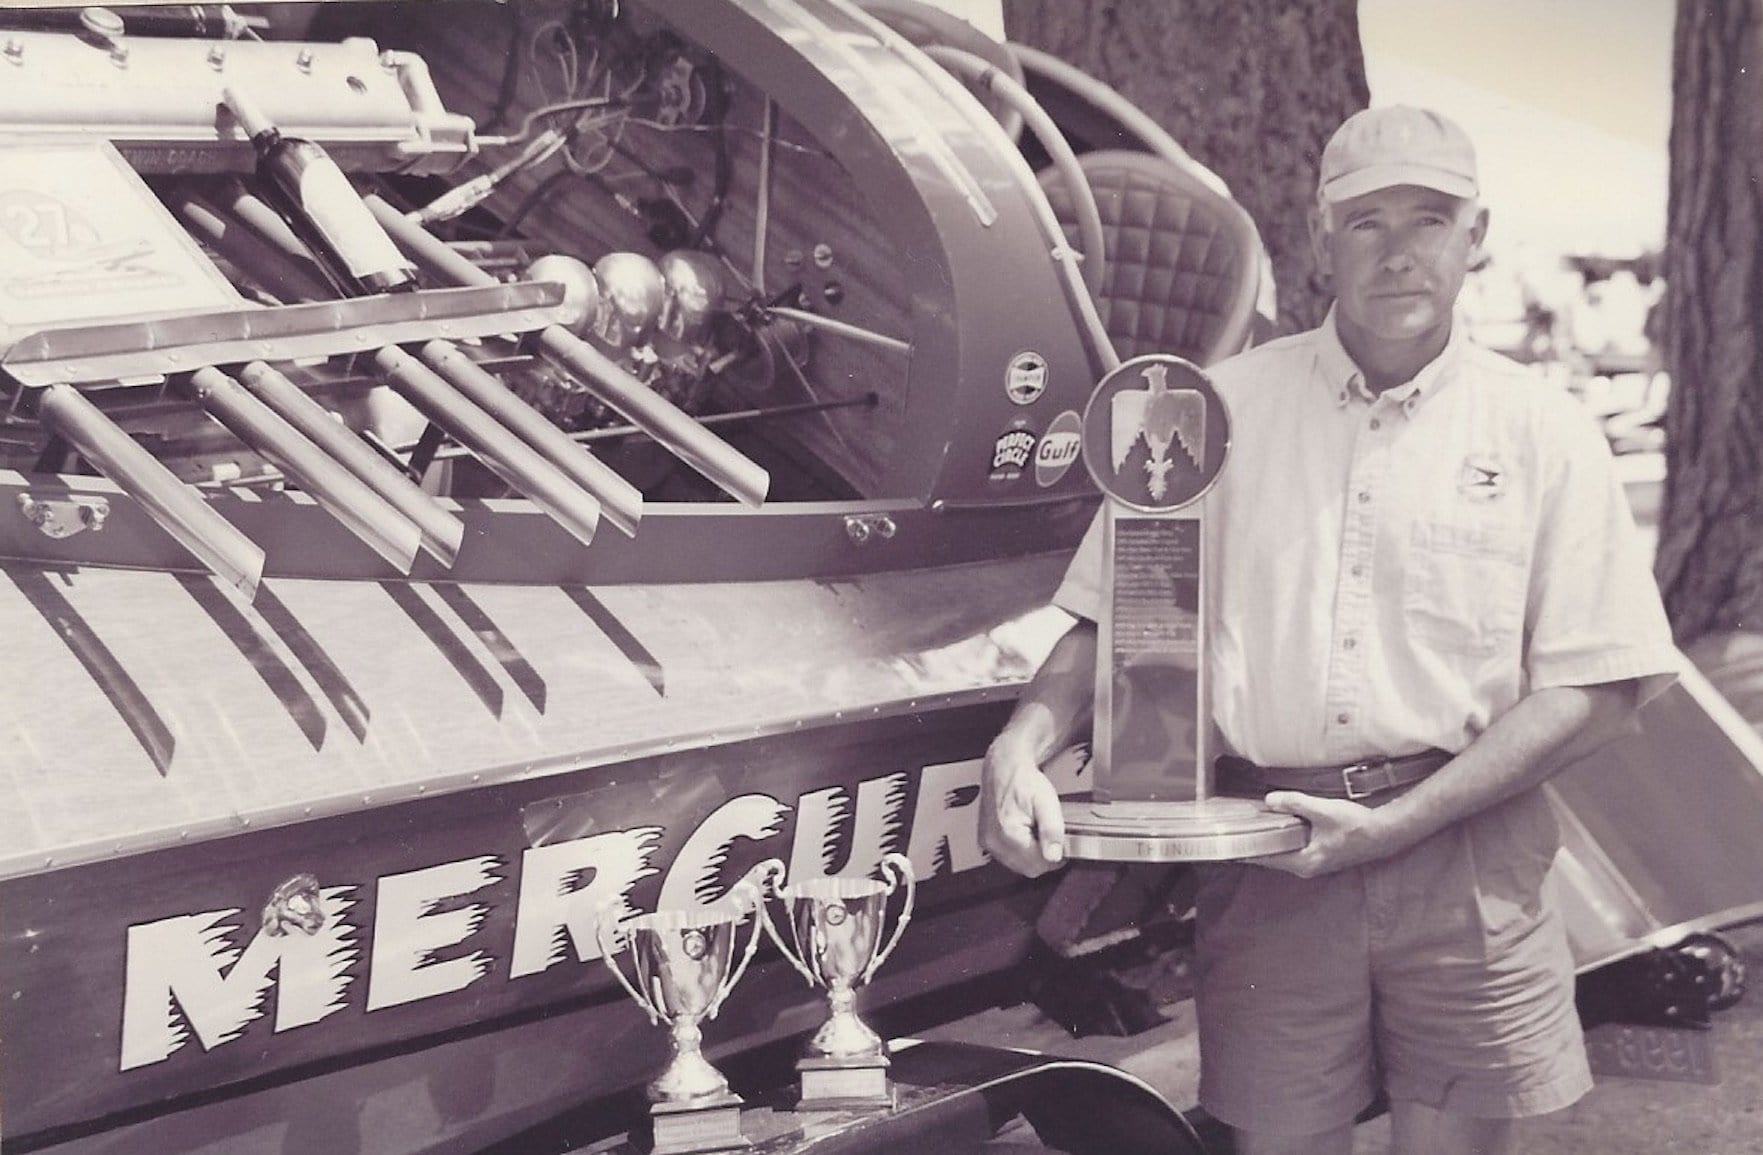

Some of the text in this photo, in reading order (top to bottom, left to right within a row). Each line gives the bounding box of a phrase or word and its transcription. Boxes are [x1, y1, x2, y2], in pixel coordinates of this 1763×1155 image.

[6, 204, 69, 248] 27
[993, 447, 1029, 467] CIRCLE
[1039, 440, 1079, 461] Gulf
